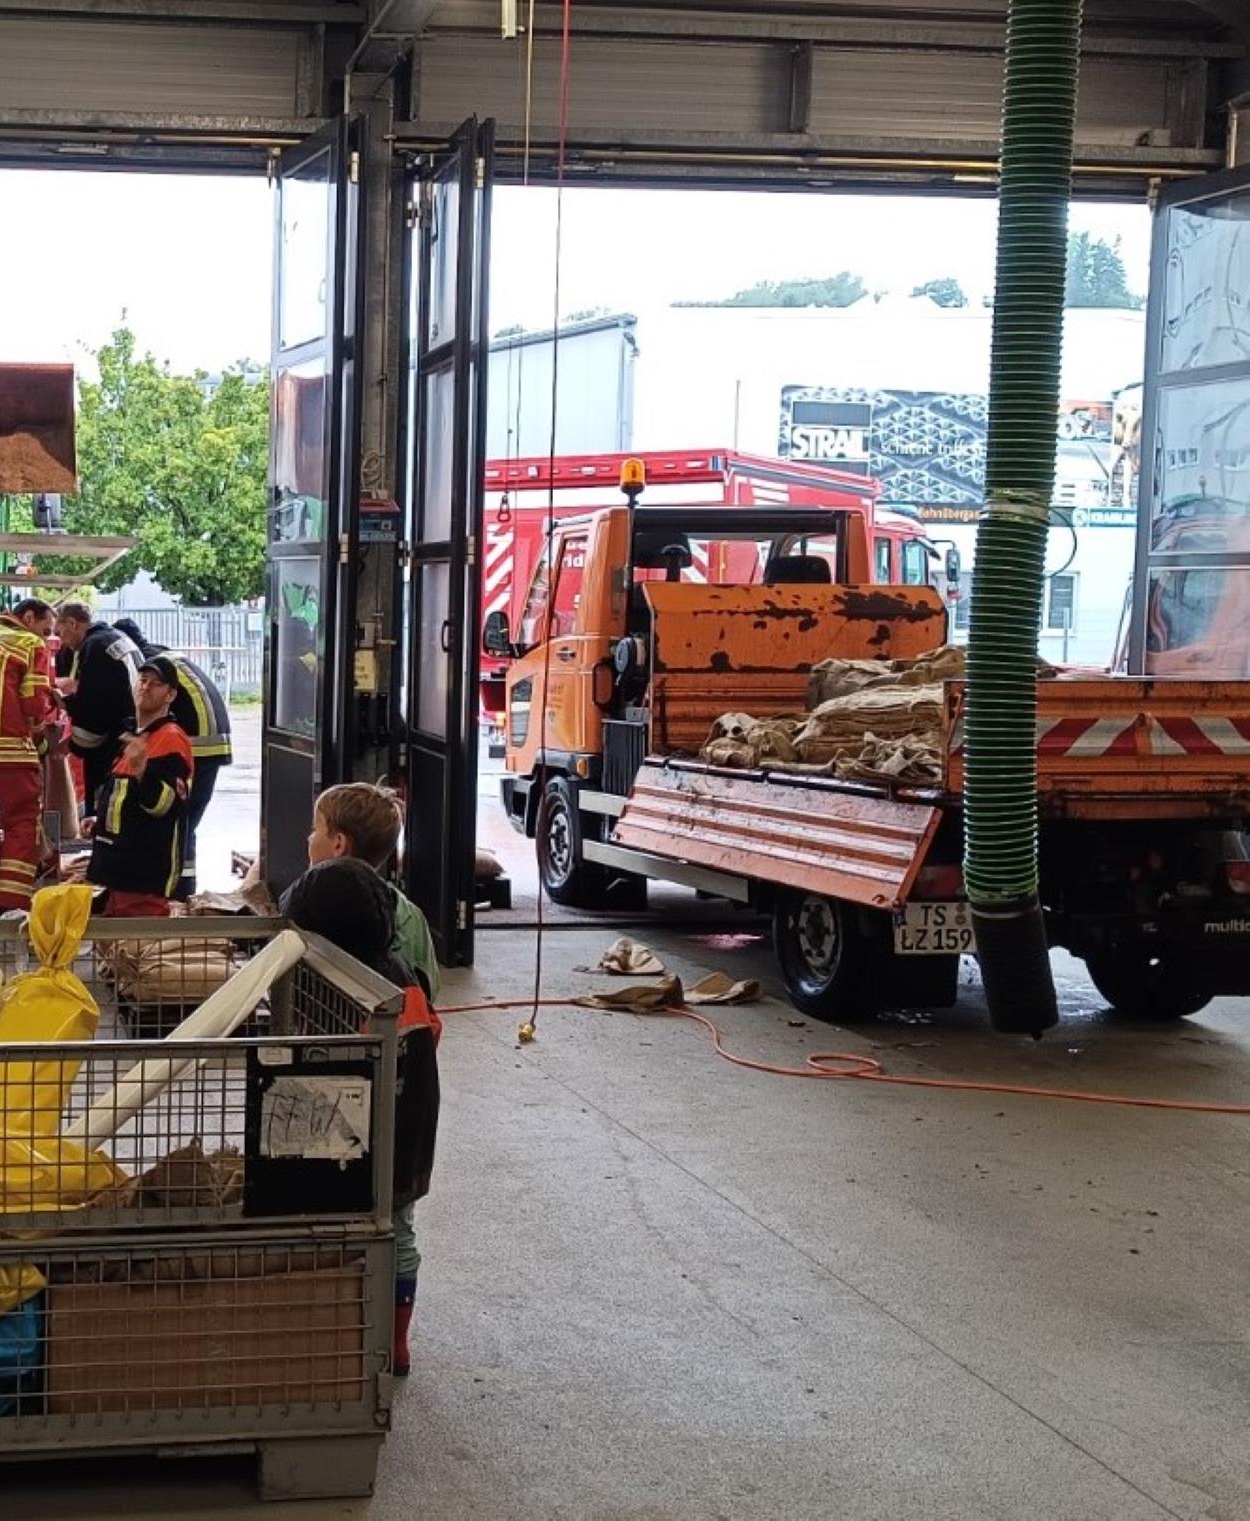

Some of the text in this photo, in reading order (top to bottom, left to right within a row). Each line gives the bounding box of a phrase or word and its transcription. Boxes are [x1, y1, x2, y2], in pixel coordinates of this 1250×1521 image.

[921, 905, 947, 926] TS
[901, 928, 972, 950] LZ 159
